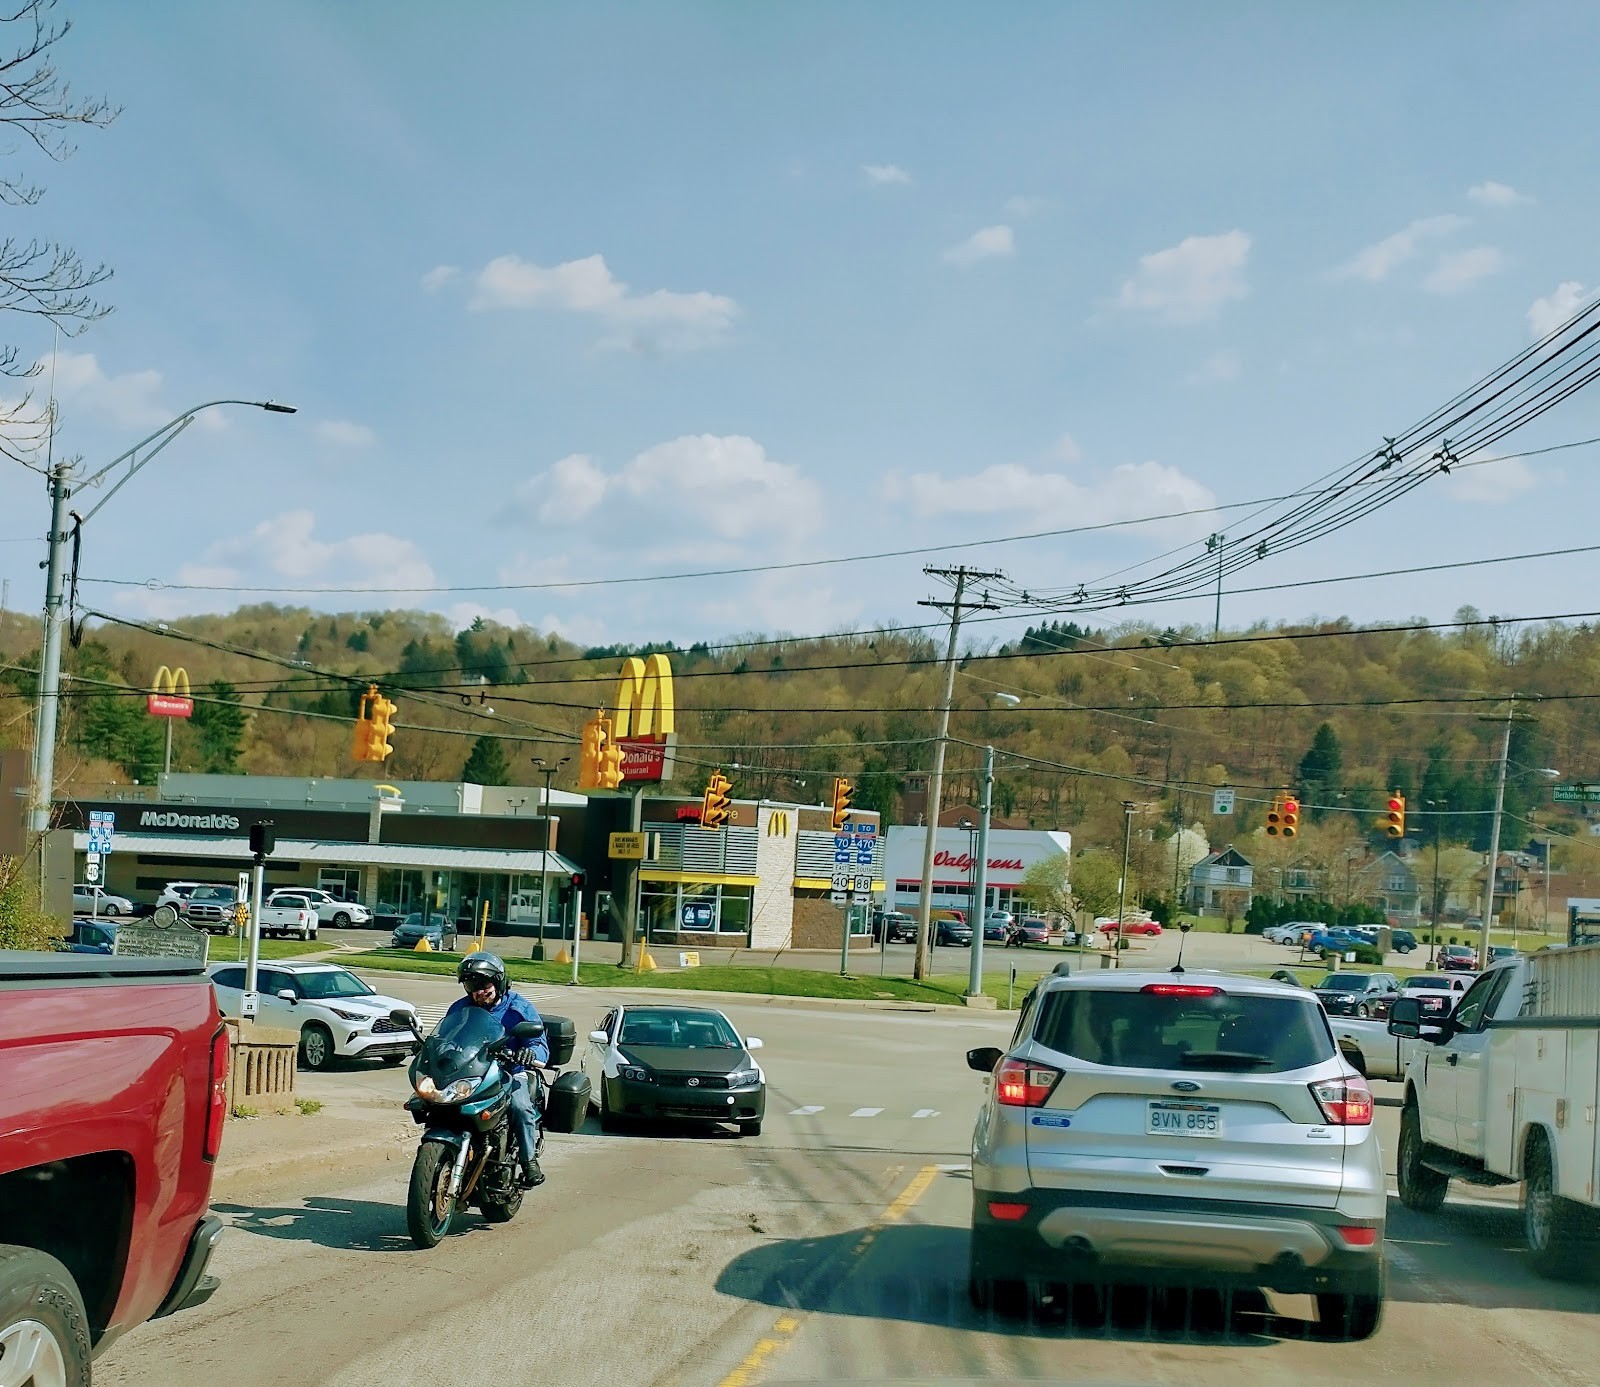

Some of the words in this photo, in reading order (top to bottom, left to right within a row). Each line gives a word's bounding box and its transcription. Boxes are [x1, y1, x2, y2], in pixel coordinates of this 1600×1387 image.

[140, 811, 240, 830] McDonald's
[91, 827, 100, 838] 70
[103, 828, 111, 839] 70
[837, 838, 849, 848] 70
[856, 839, 874, 849] 470
[88, 867, 98, 878] 40
[832, 877, 848, 888] 40
[856, 878, 869, 890] 88
[685, 906, 695, 919] 24
[1151, 1112, 1180, 1128] 8VN
[1187, 1114, 1216, 1130] 855
